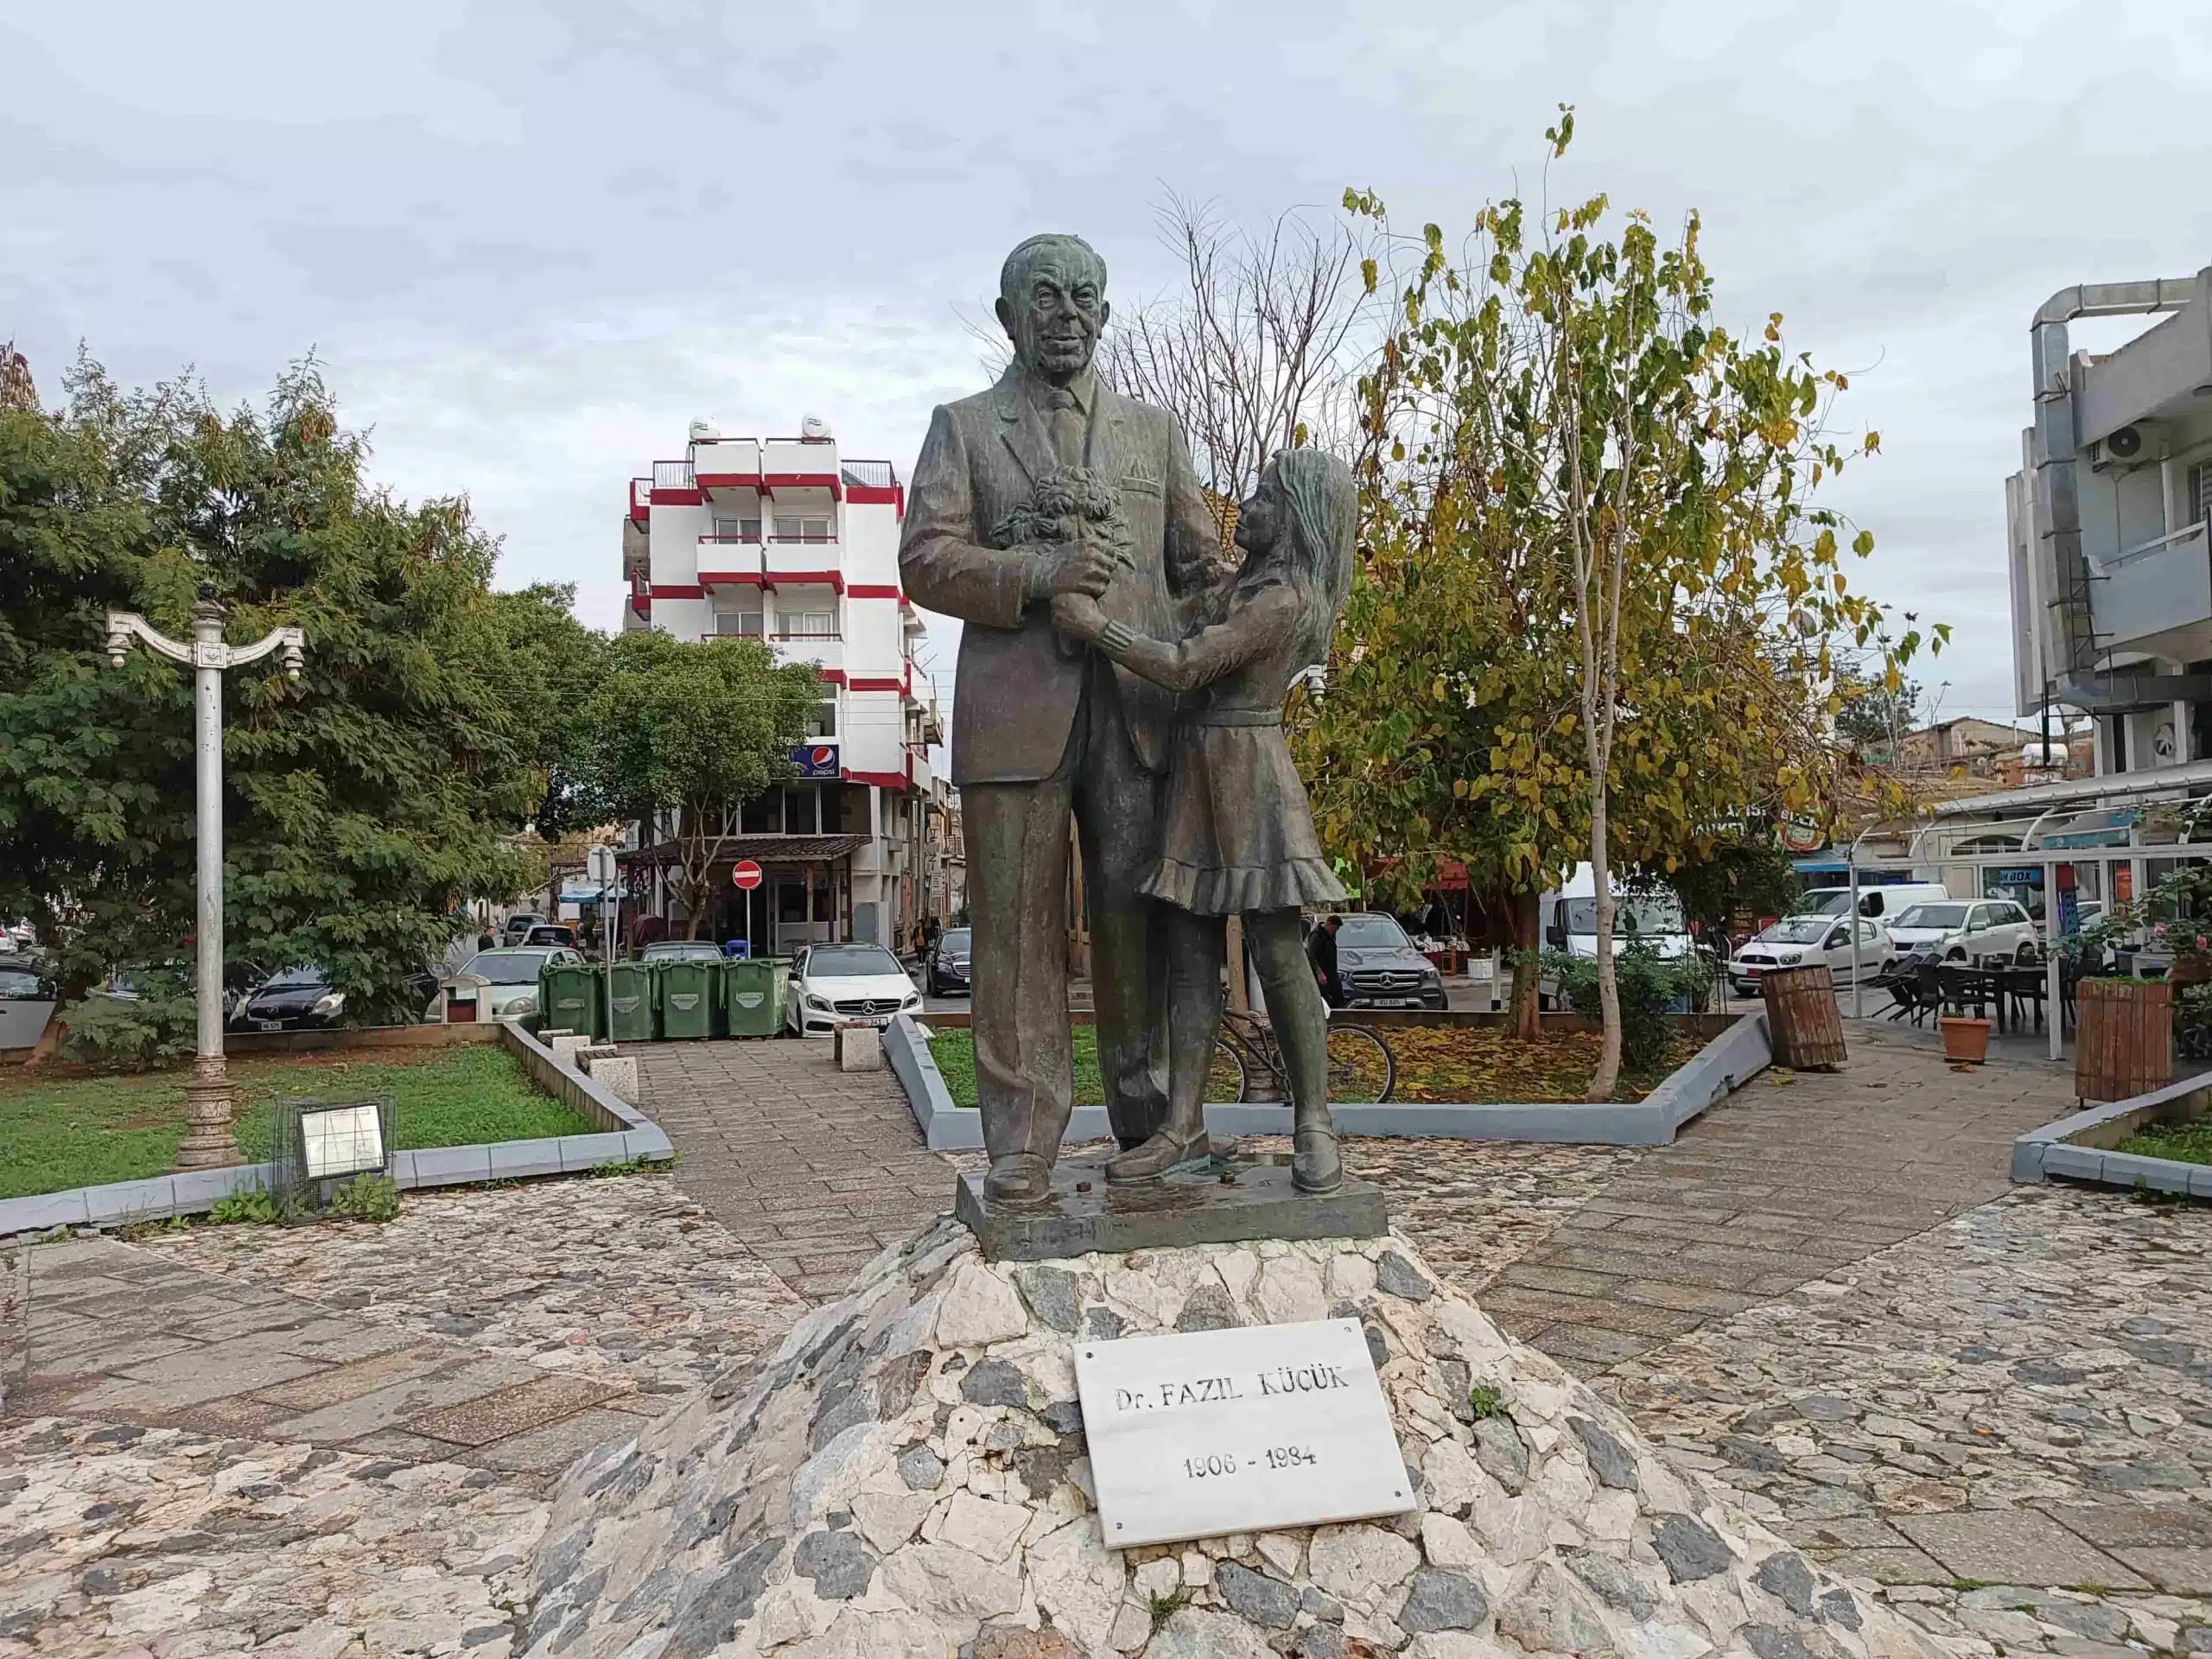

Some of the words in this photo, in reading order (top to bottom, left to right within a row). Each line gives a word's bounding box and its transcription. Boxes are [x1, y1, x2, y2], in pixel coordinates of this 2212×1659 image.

[1115, 1389, 1154, 1411] Dr.
[1160, 1377, 1243, 1407] FAZIL
[1257, 1363, 1349, 1395] KÜÇÜK
[1184, 1453, 1236, 1478] 1906
[1266, 1446, 1317, 1470] 1984
